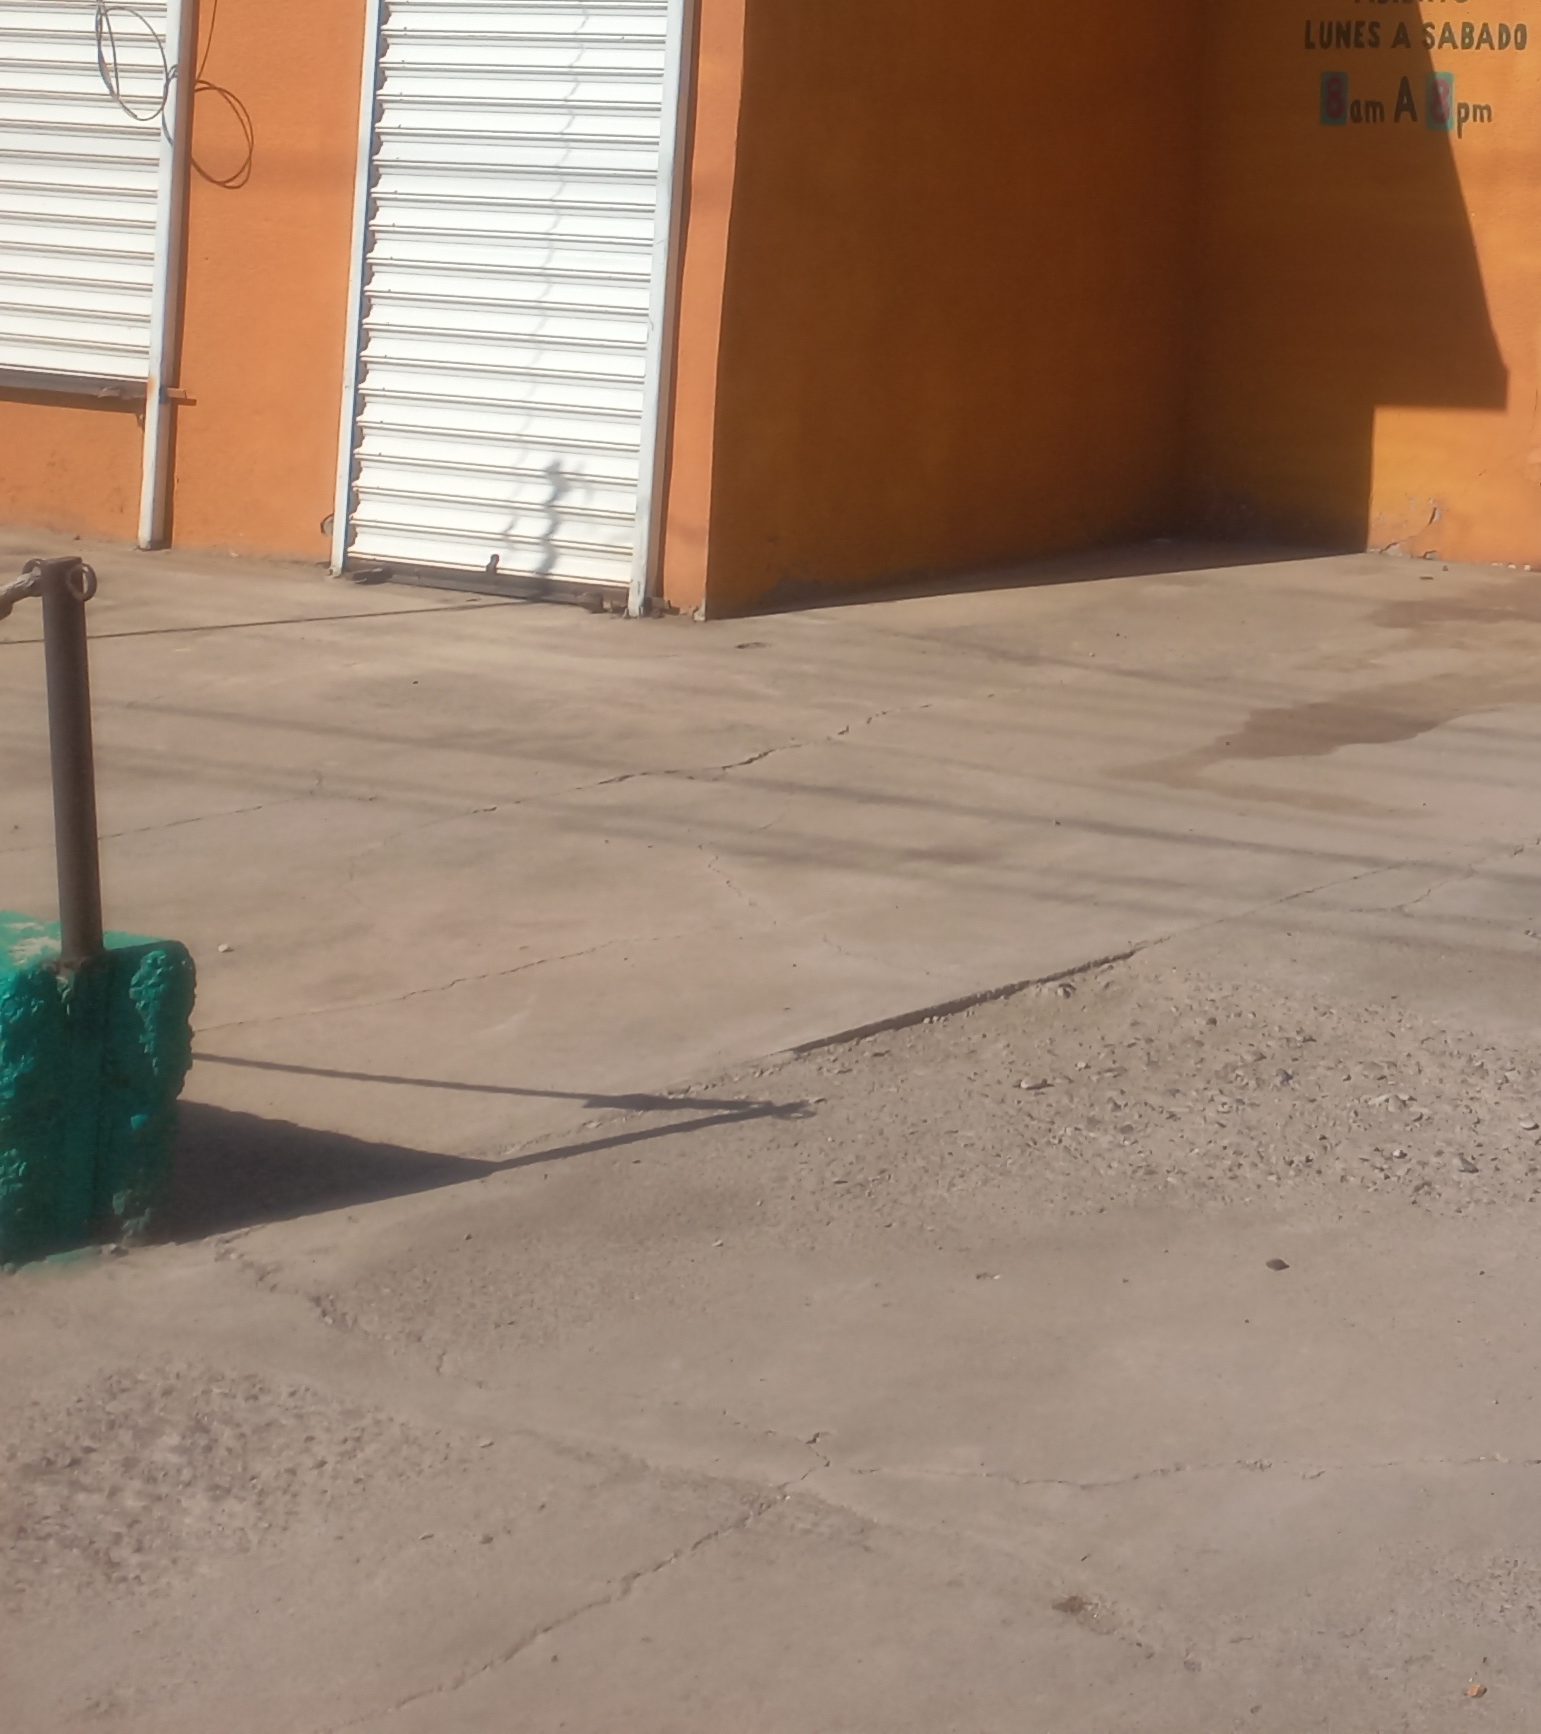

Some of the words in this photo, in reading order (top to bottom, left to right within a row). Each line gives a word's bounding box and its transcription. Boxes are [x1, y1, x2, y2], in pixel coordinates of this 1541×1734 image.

[1304, 20, 1381, 50] LUNES
[1391, 22, 1411, 49] A
[1424, 22, 1527, 50] SABADO
[1394, 76, 1417, 123] A
